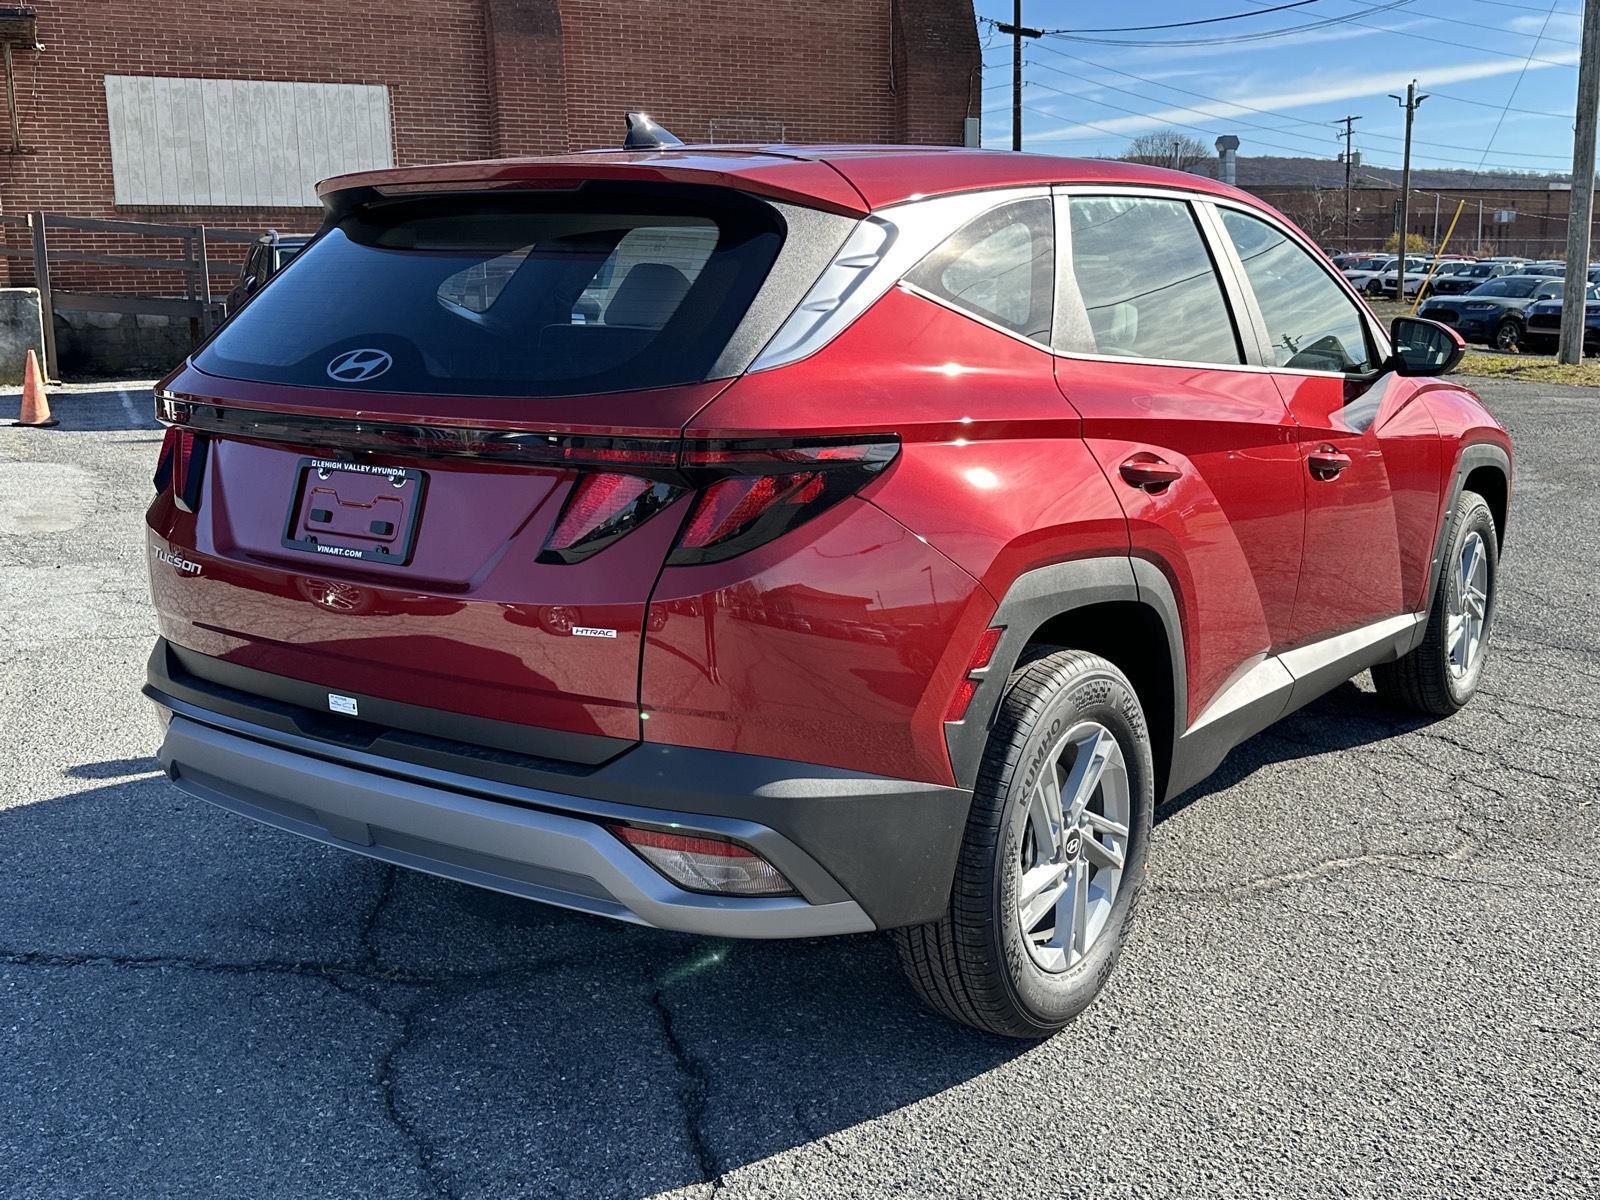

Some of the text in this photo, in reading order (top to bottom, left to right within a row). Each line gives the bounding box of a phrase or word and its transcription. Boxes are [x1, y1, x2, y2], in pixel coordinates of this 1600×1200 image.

[317, 460, 406, 477] LEHIGH VALLEY HYUNDAI
[317, 545, 363, 558] VINART.COM
[575, 628, 614, 637] HTRAC
[1019, 718, 1061, 807] KUMHO
